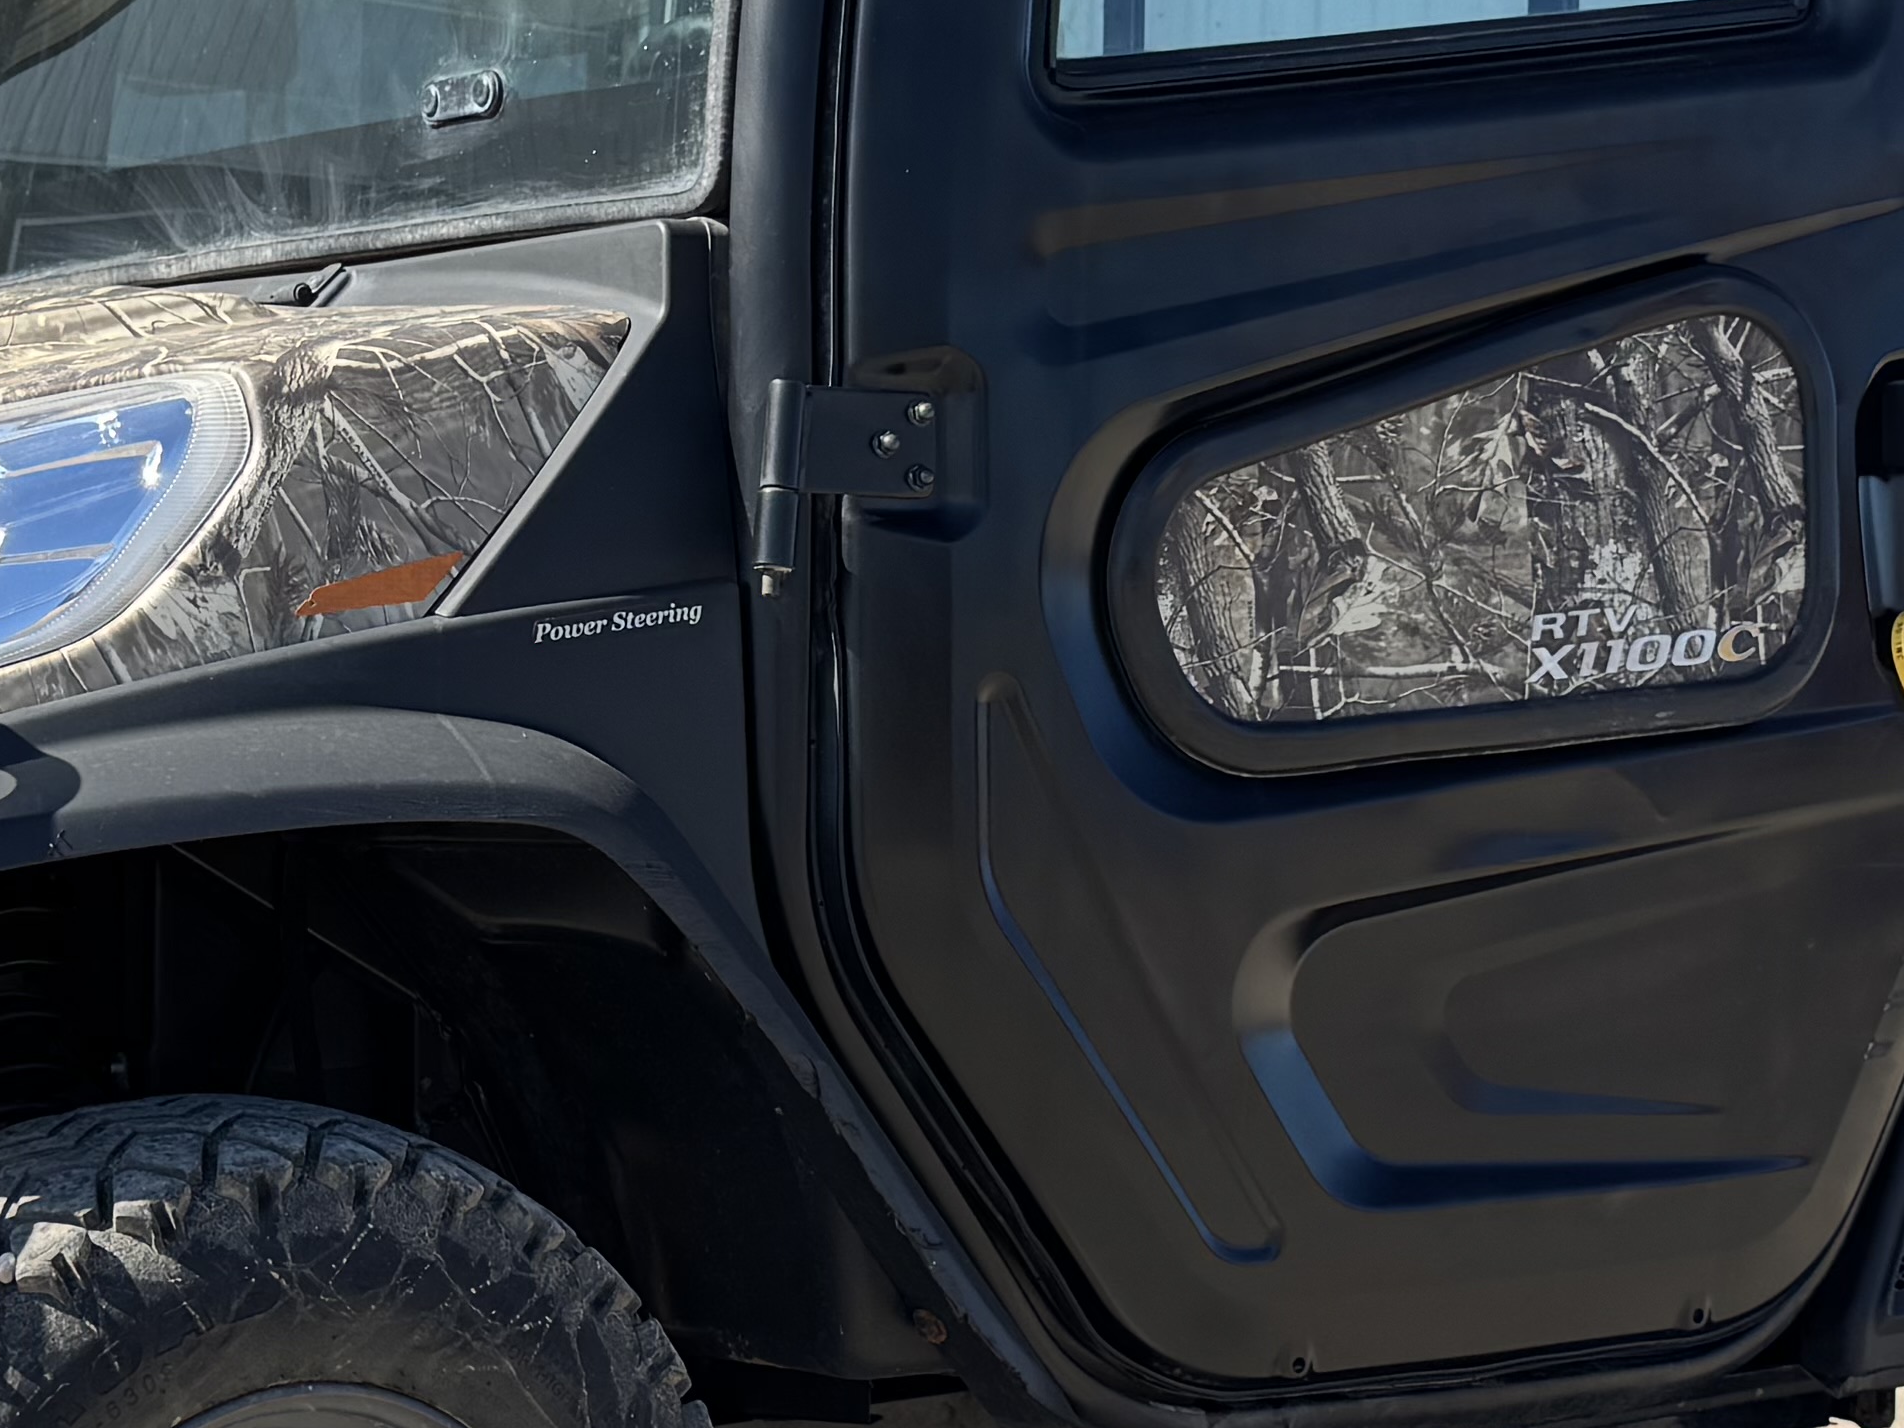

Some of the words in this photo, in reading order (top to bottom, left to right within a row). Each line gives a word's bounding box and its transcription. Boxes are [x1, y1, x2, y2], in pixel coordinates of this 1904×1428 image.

[534, 618, 608, 644] Power
[610, 602, 703, 632] Steering
[1531, 605, 1639, 642] RTV
[1525, 622, 1760, 684] X1100C
